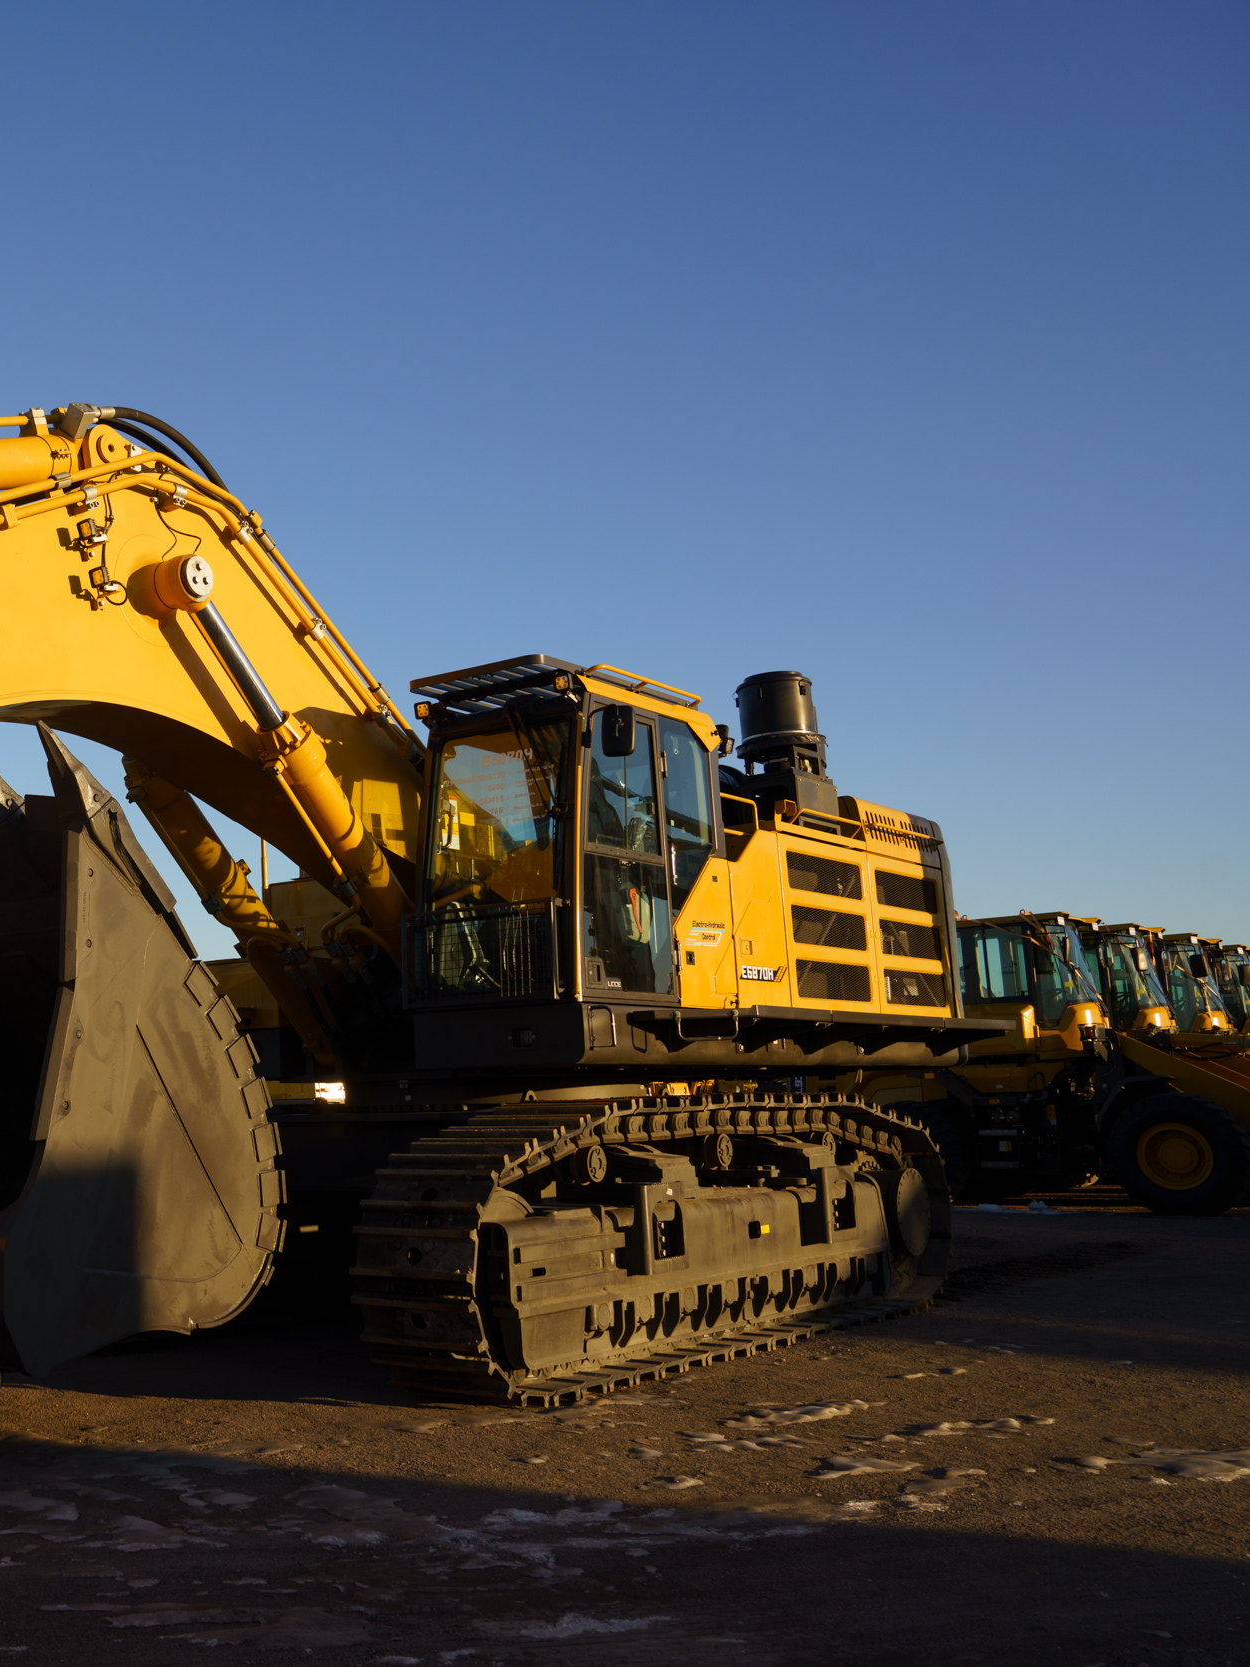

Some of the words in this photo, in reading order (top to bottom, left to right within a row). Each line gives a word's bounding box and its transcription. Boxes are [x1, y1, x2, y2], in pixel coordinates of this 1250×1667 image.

[482, 748, 533, 768] E6870H
[487, 783, 505, 791] 8400
[490, 806, 503, 815] 765
[692, 920, 725, 929] Electro-Hydraulic
[741, 965, 774, 980] E6870H
